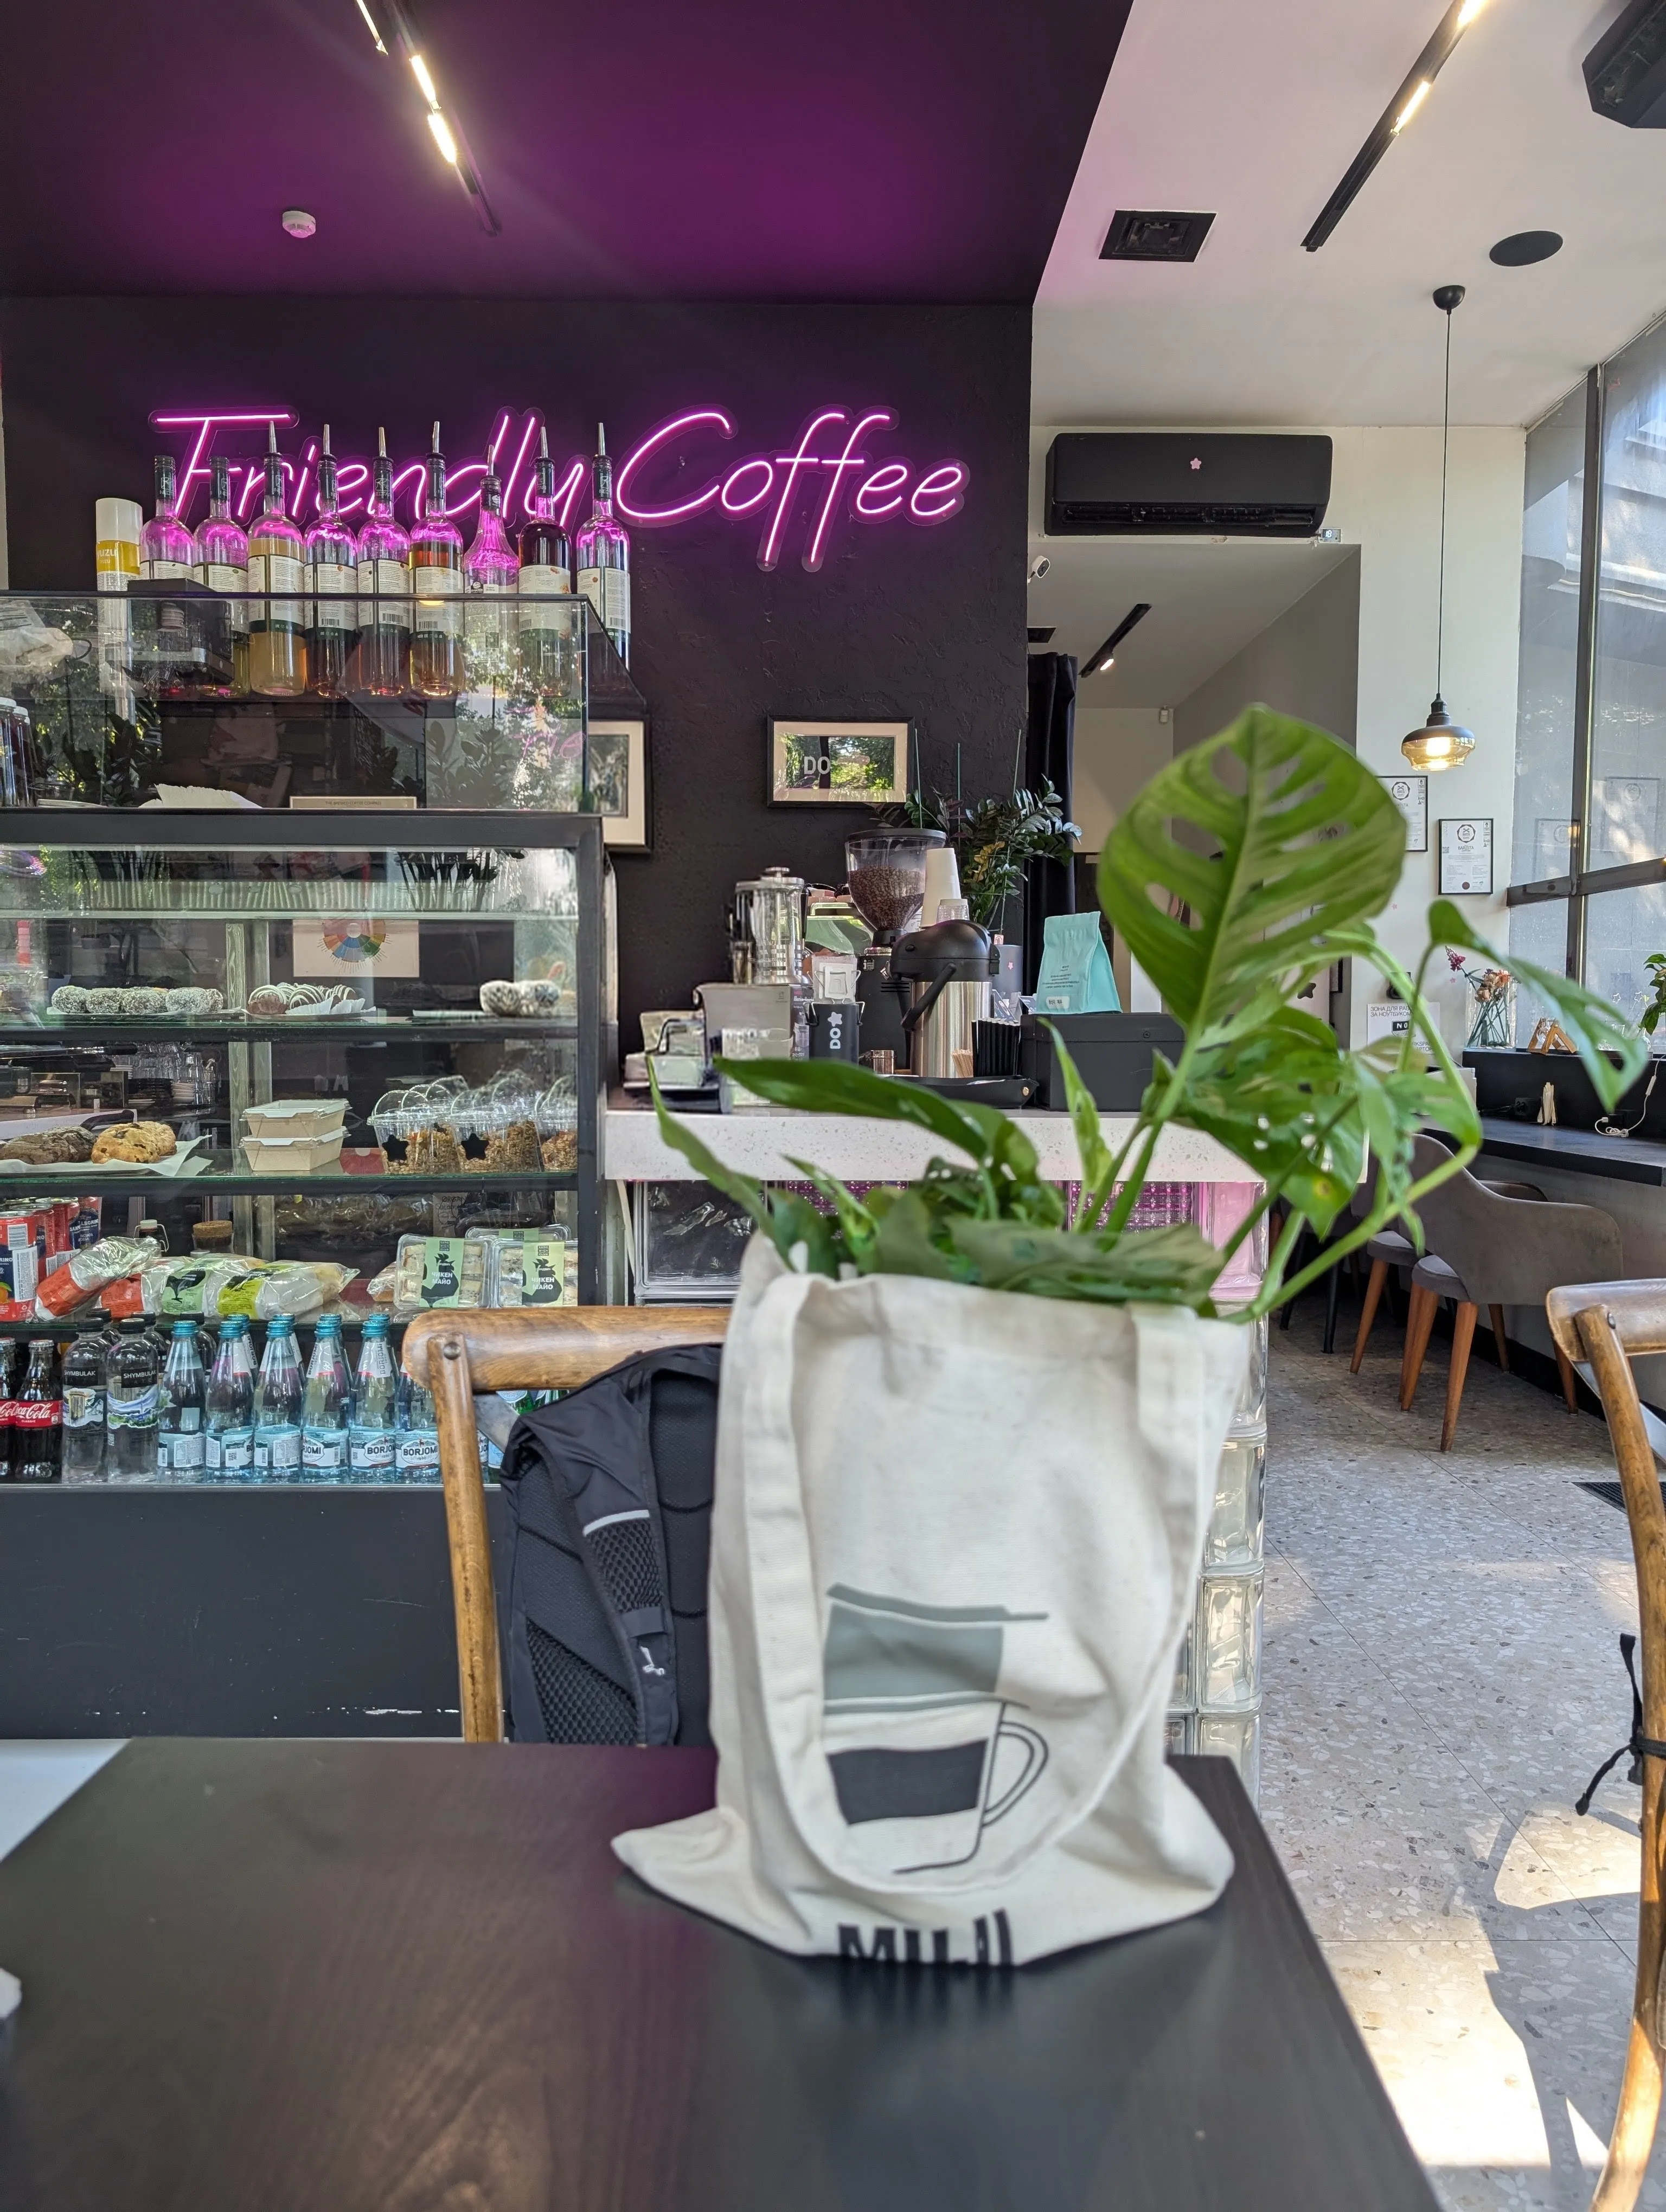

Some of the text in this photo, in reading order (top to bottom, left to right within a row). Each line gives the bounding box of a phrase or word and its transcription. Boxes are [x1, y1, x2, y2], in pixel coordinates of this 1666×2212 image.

[155, 411, 963, 563] Friendly Coffee
[804, 756, 831, 775] DO
[829, 1027, 841, 1049] DO
[247, 1335, 257, 1366] BORJOMI
[307, 1343, 318, 1375] BORJOMI
[123, 1369, 157, 1379] SHYMBULAK
[303, 1446, 322, 1455] JOMI
